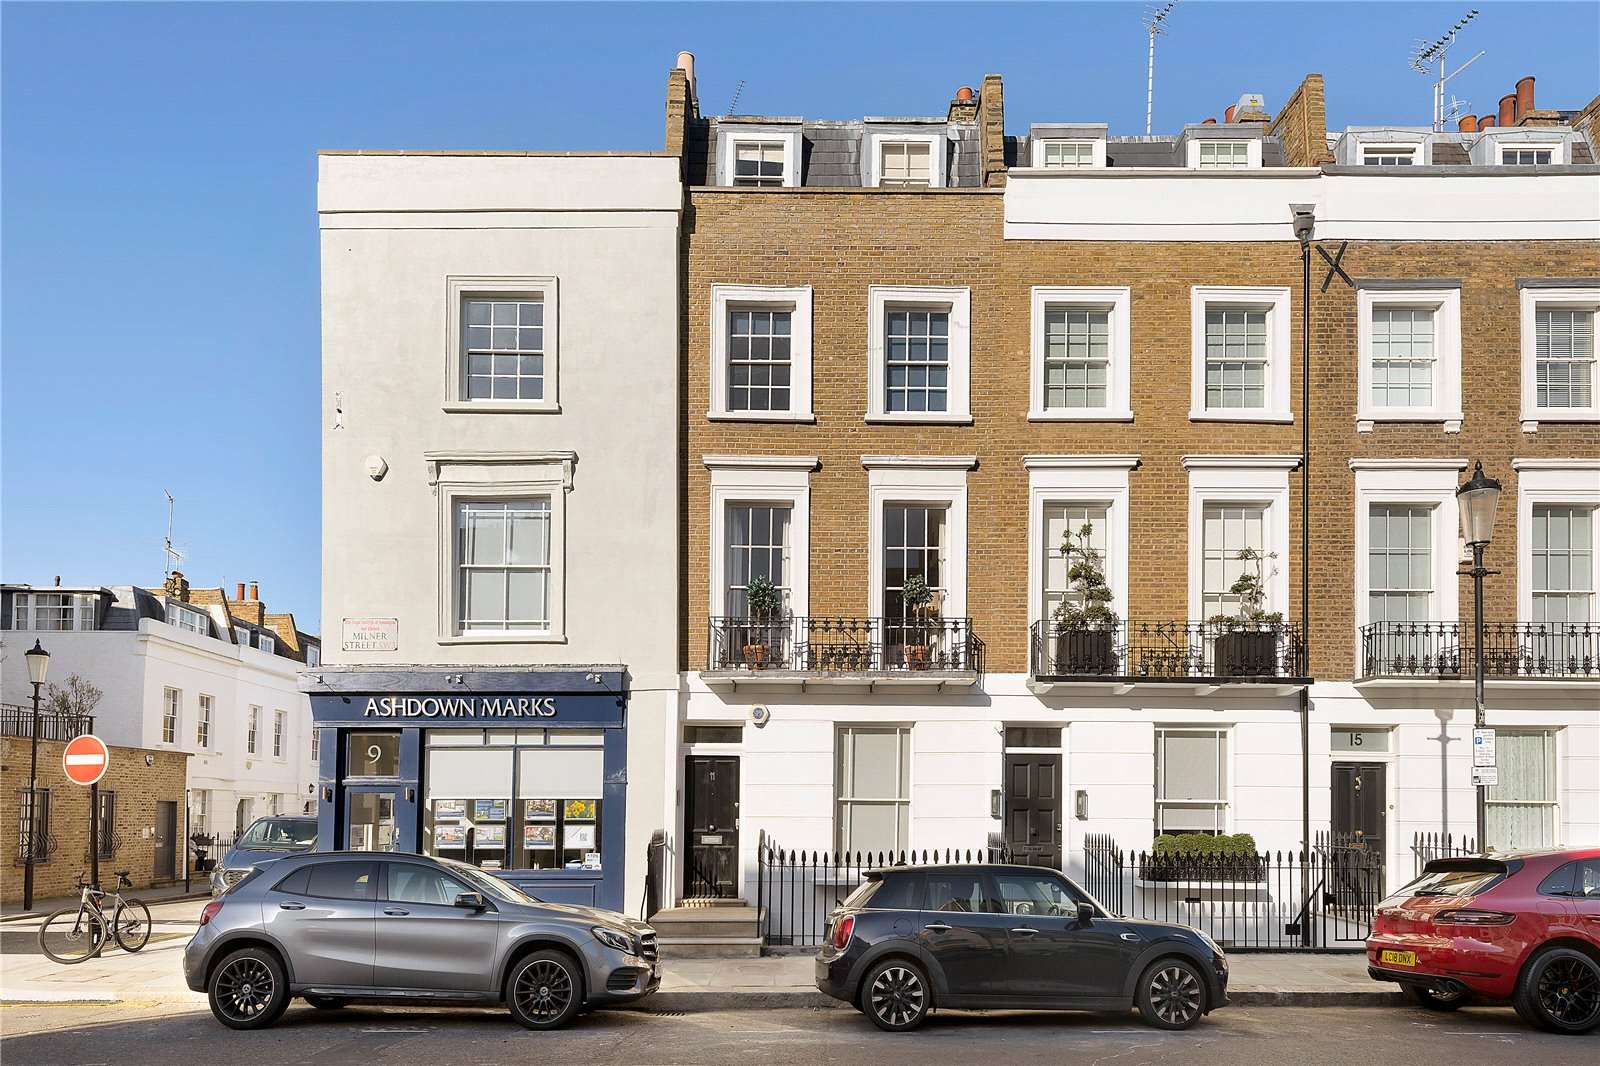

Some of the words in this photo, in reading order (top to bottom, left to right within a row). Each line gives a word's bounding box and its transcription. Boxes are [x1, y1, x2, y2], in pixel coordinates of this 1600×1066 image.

[352, 632, 388, 640] MILNER
[344, 641, 376, 649] STREET
[364, 698, 475, 717] ASHDOWN
[481, 698, 556, 717] MARKS
[1350, 733, 1363, 746] 15
[367, 745, 381, 764] 9
[1384, 951, 1398, 962] LC18
[1398, 953, 1412, 964] DNX
